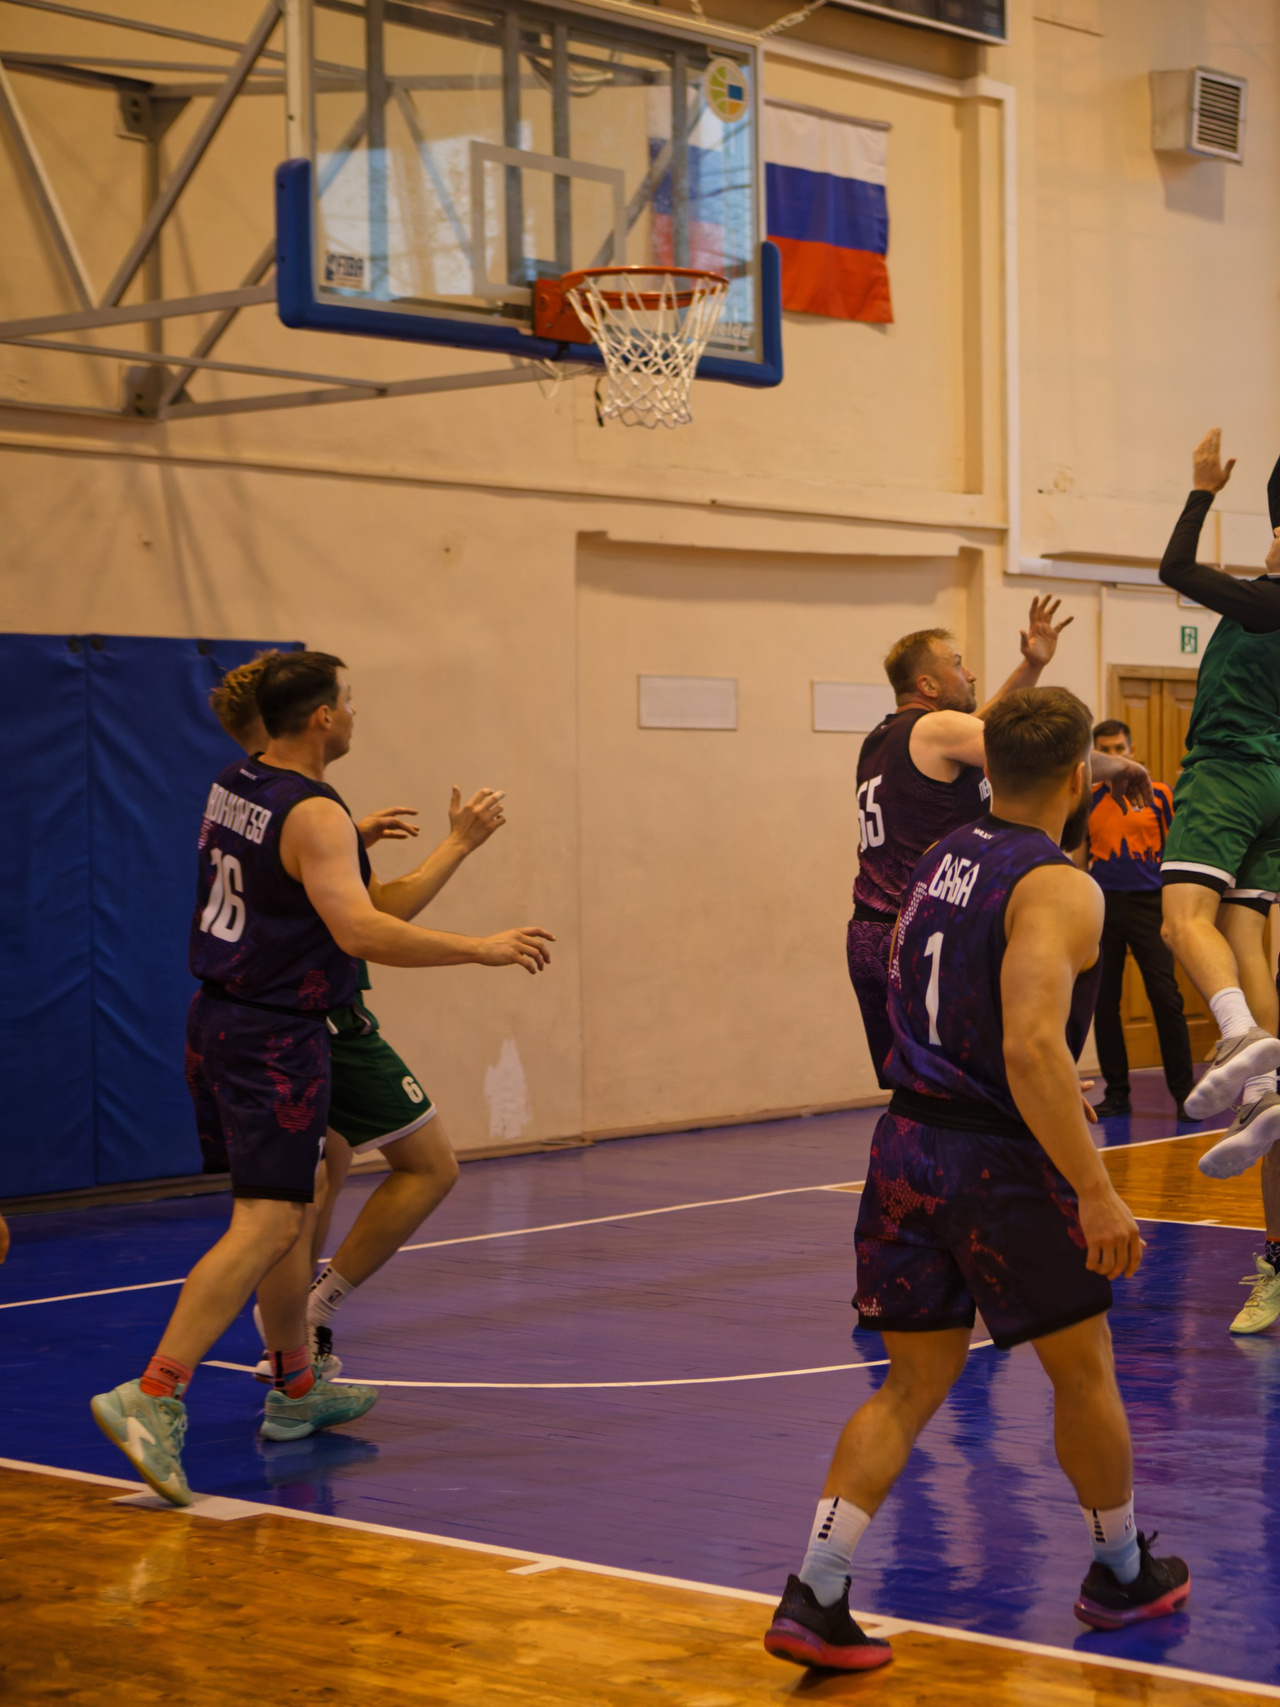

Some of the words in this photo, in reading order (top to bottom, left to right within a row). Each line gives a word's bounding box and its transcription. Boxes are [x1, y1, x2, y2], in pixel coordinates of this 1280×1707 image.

[200, 847, 246, 943] 16
[928, 852, 980, 908] САБА
[923, 931, 945, 1046] 1
[401, 1075, 424, 1104] 6
